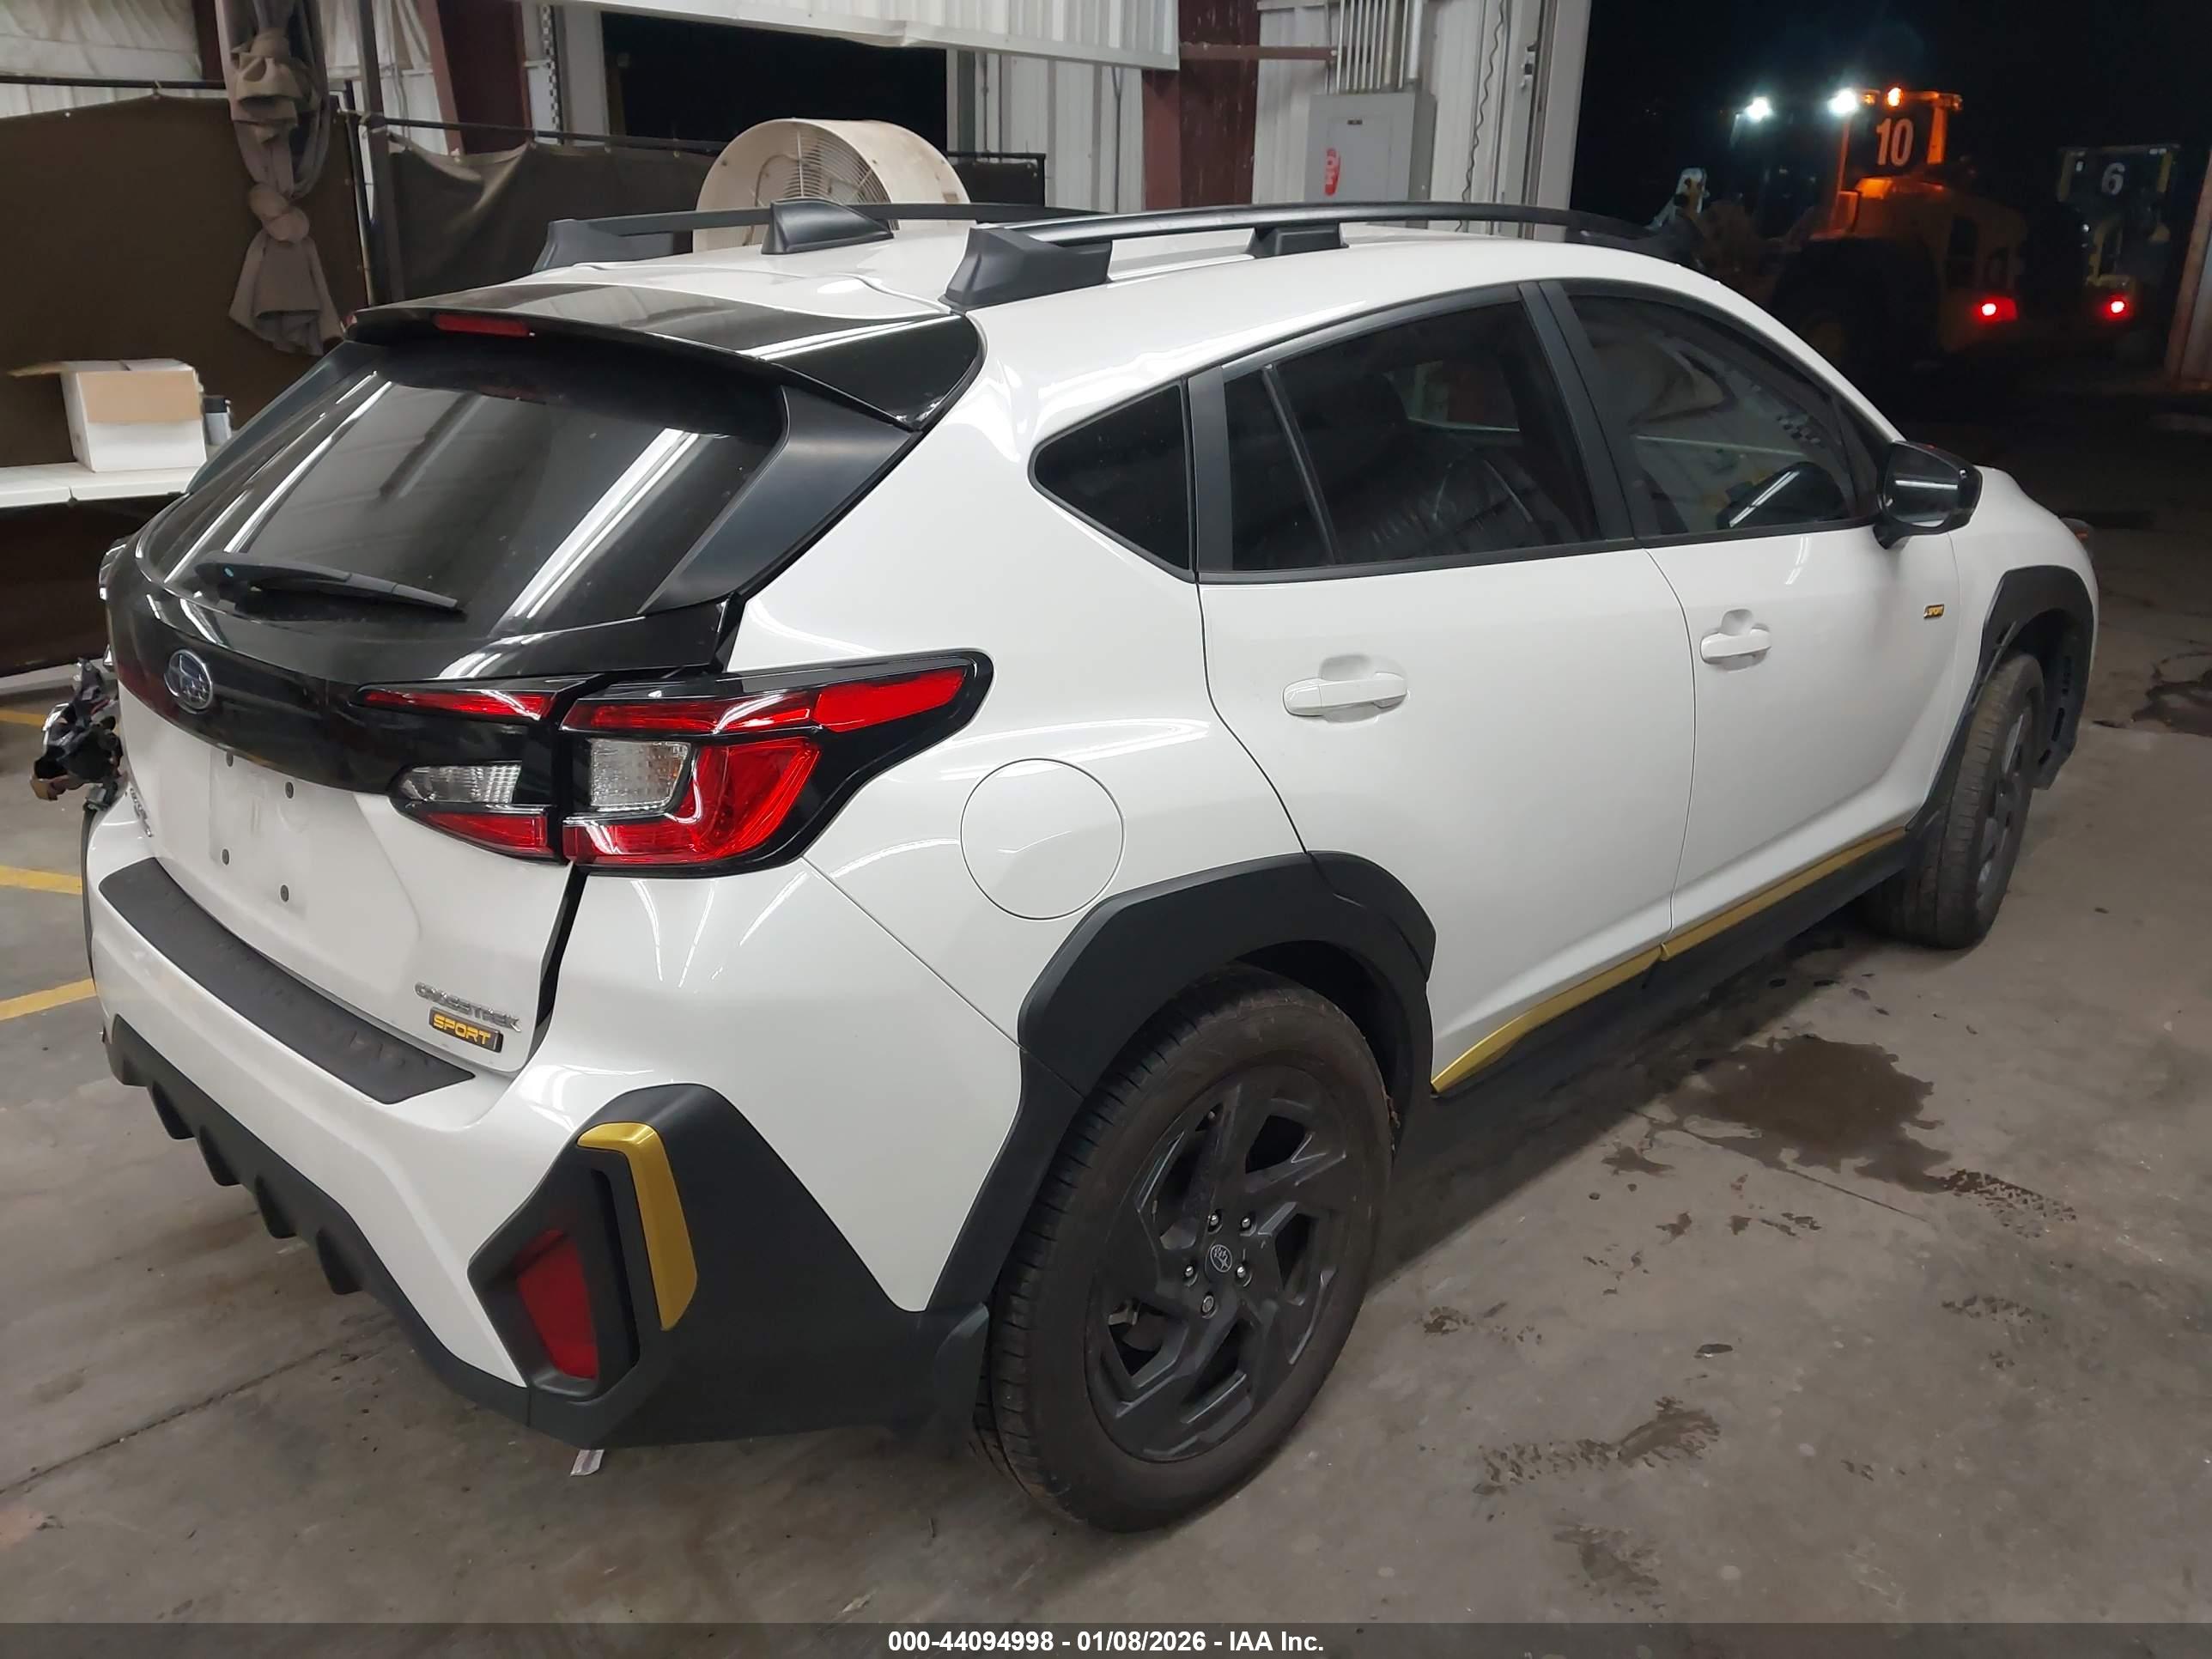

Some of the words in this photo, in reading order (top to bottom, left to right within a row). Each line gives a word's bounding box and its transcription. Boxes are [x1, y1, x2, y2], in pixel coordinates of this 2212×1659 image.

[1875, 118, 1914, 167] 10
[2102, 162, 2124, 196] 6
[433, 1013, 491, 1045] SPORT
